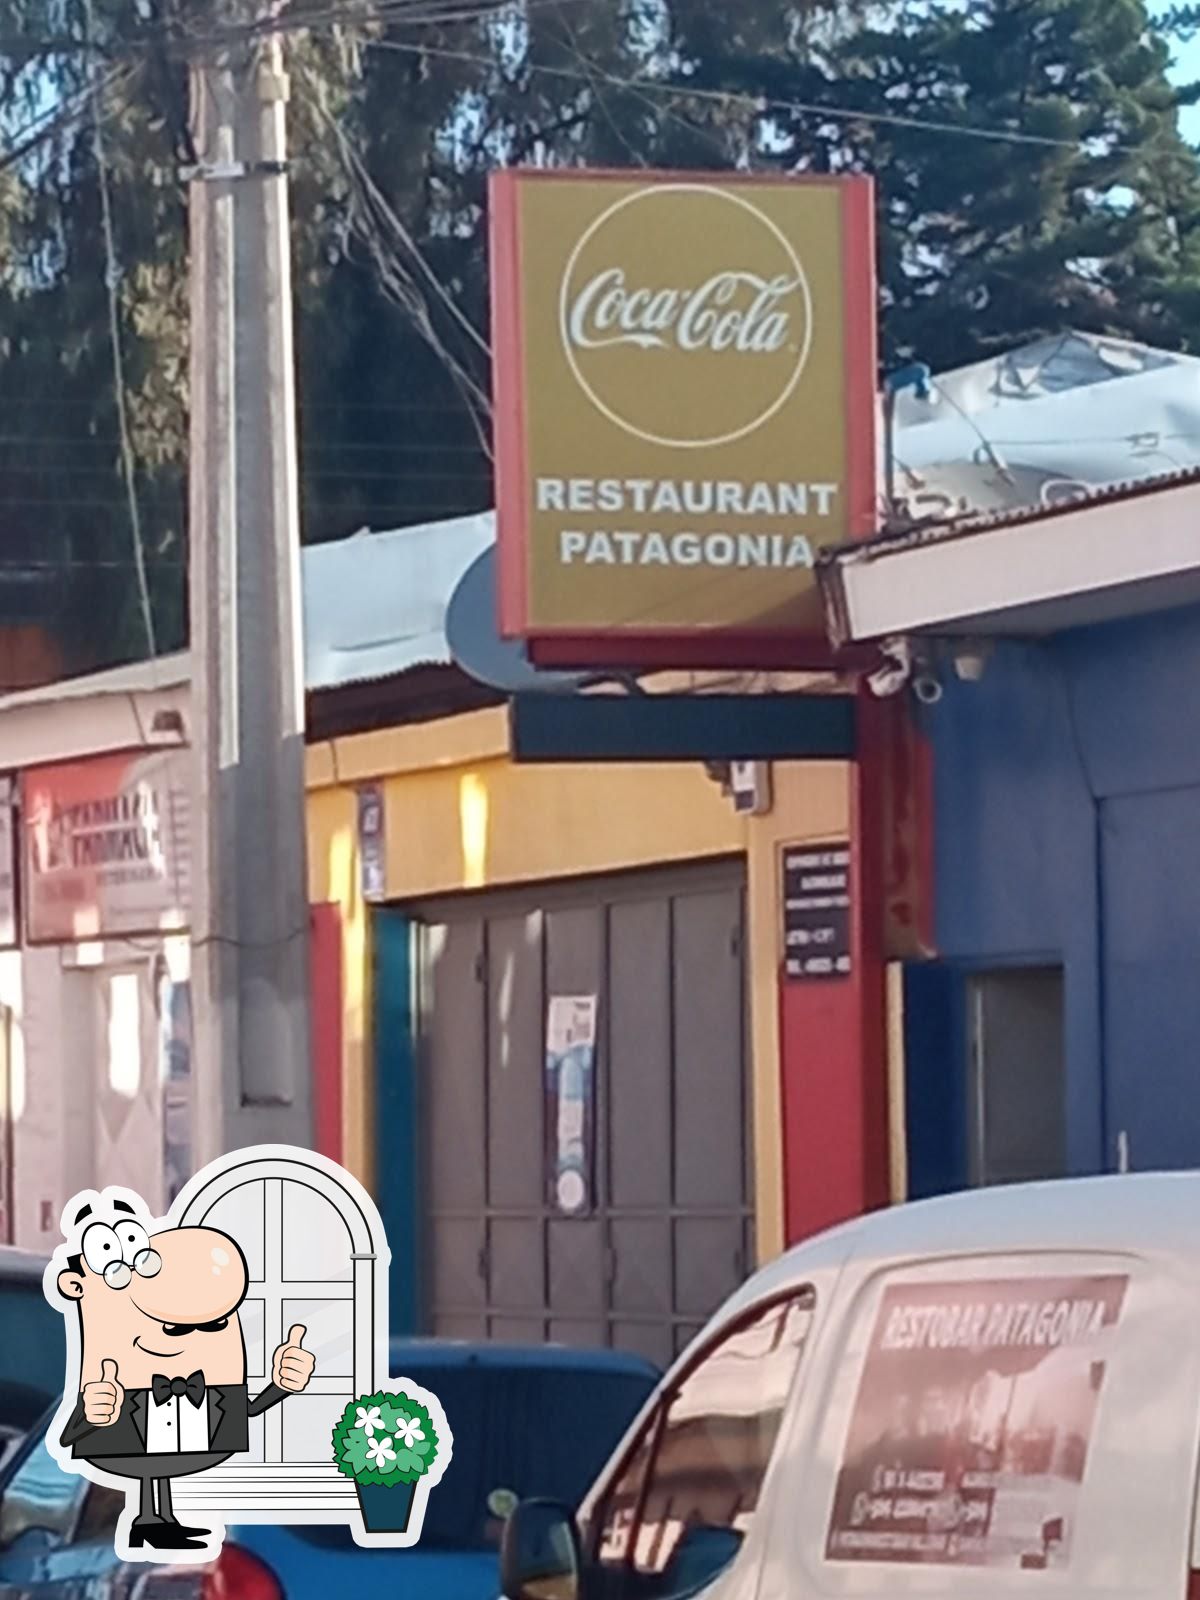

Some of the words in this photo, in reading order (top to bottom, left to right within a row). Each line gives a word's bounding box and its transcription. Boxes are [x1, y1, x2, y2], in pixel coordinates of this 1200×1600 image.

[570, 267, 801, 352] Coca-Cola
[536, 478, 838, 515] RESTAURANT
[560, 531, 814, 567] PATAGONIA
